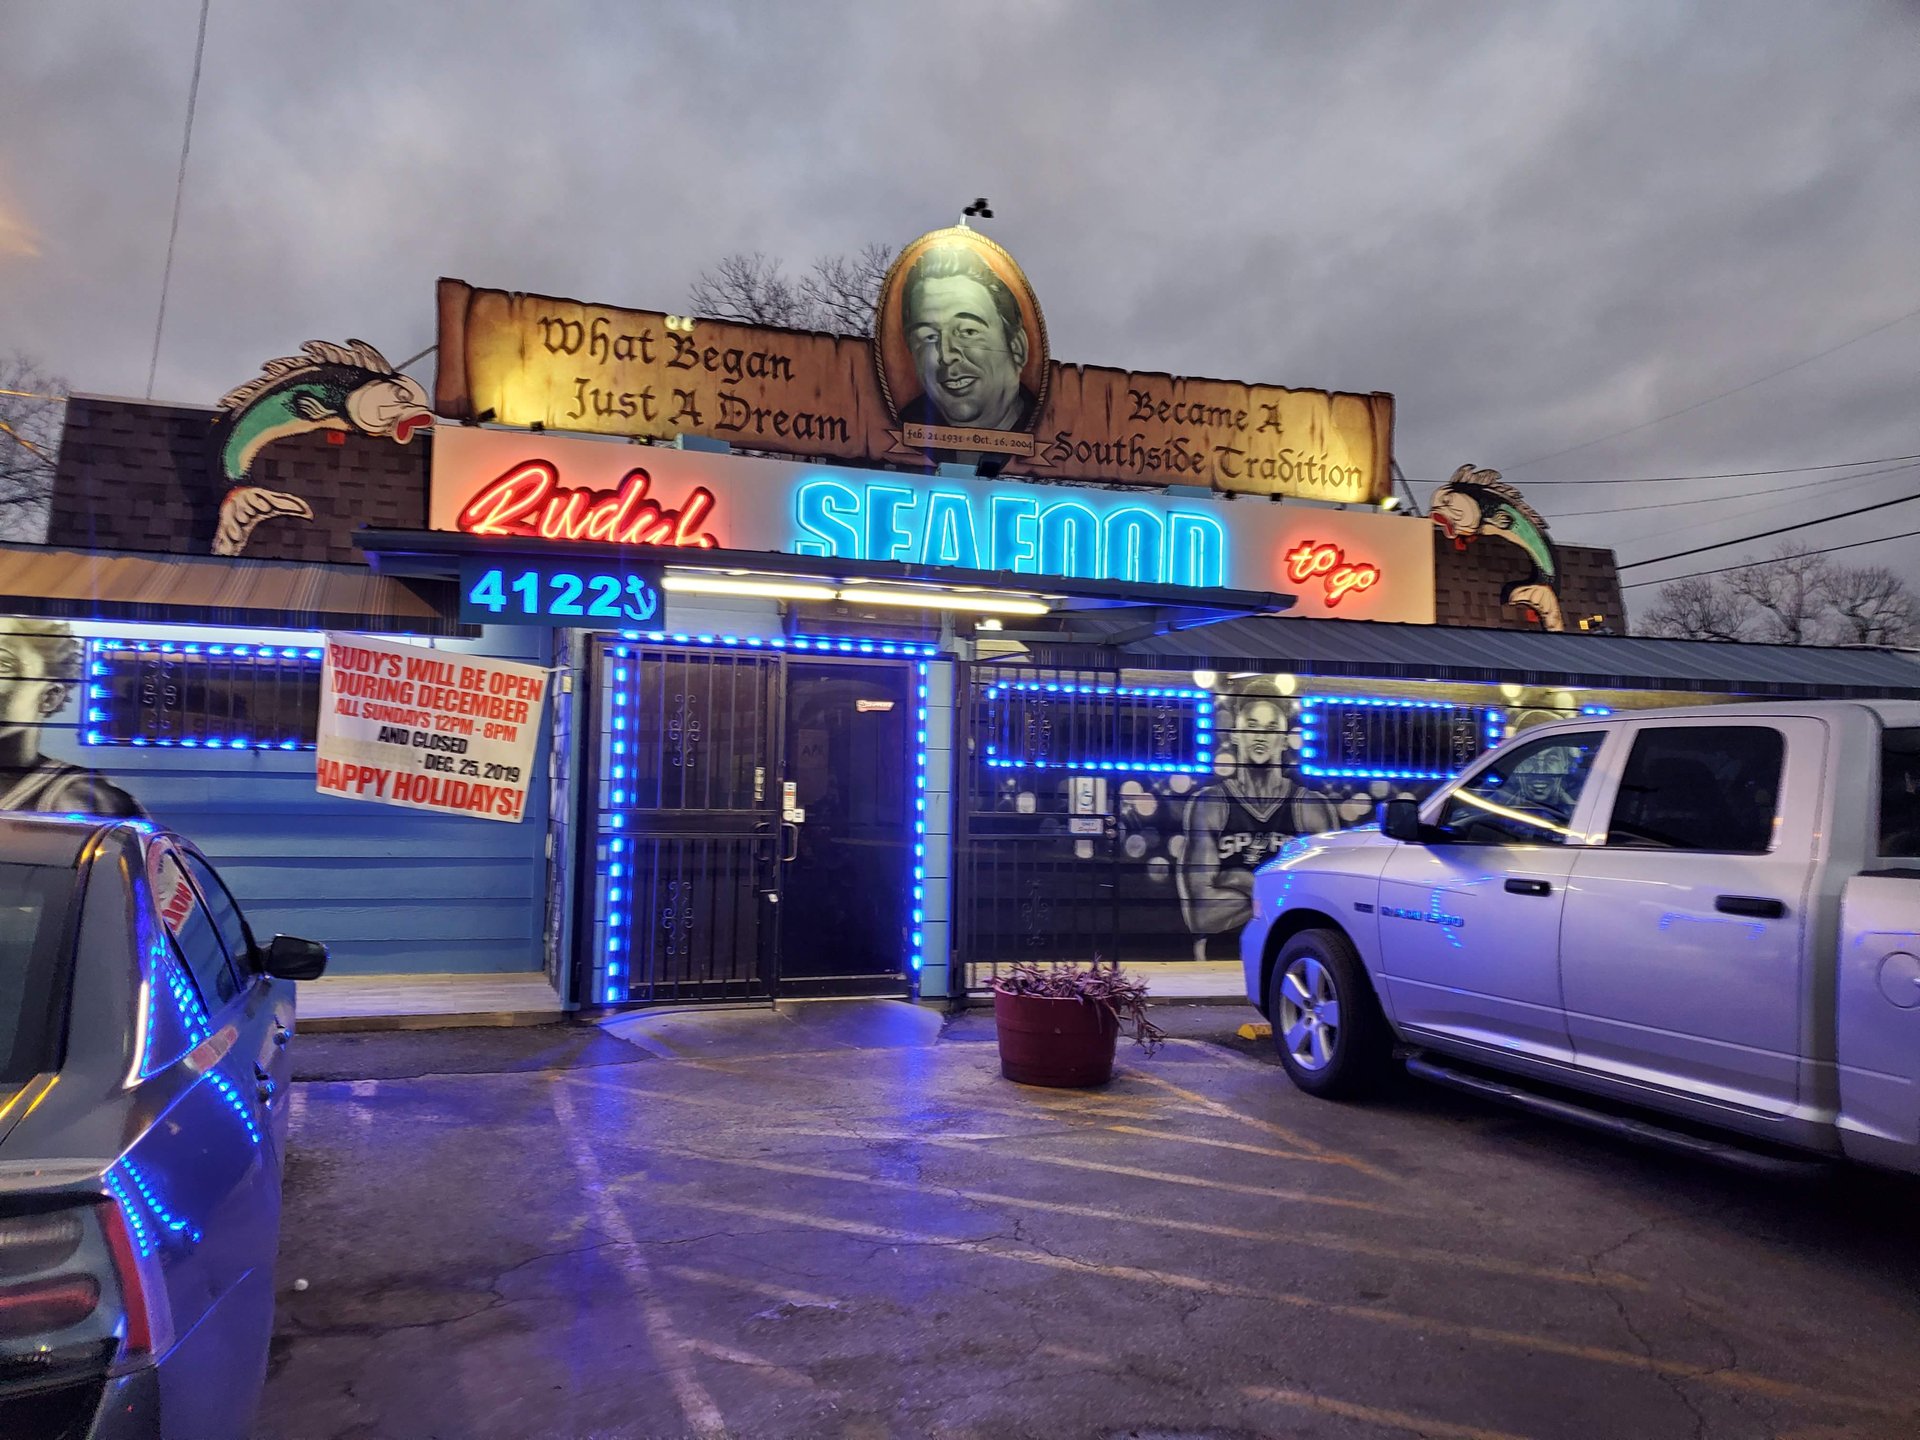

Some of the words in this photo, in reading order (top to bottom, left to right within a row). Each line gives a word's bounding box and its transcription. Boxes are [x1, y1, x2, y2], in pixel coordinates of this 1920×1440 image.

[538, 316, 656, 365] What
[666, 332, 794, 384] Began
[567, 378, 658, 421] Just
[668, 389, 703, 426] A
[716, 389, 850, 443] Dream
[1128, 389, 1249, 431] Became
[1257, 400, 1284, 434] A
[1011, 440, 1032, 450] 2004
[1052, 431, 1205, 474] Southside
[1213, 446, 1363, 488] Tradition
[794, 481, 1225, 587] SEAFOOD
[1284, 540, 1344, 584] to
[1324, 563, 1380, 608] go
[469, 570, 622, 618] 4122
[327, 644, 402, 678] RUDY'S
[407, 657, 455, 687] WILL
[459, 666, 488, 692] BE
[489, 672, 543, 704] OPEN
[331, 670, 414, 705] DURING
[417, 684, 528, 724] DECEMBER
[335, 698, 359, 717] ALL
[362, 702, 430, 728] SUNDAYS
[435, 715, 473, 735] 12PM
[483, 722, 517, 742] 8PM
[377, 726, 408, 745] AND
[412, 731, 468, 754] CLOSED
[317, 757, 391, 796] HAPPY
[392, 771, 525, 818] HOLIDAYS!
[424, 754, 456, 773] DEC.
[484, 763, 520, 782] 2019
